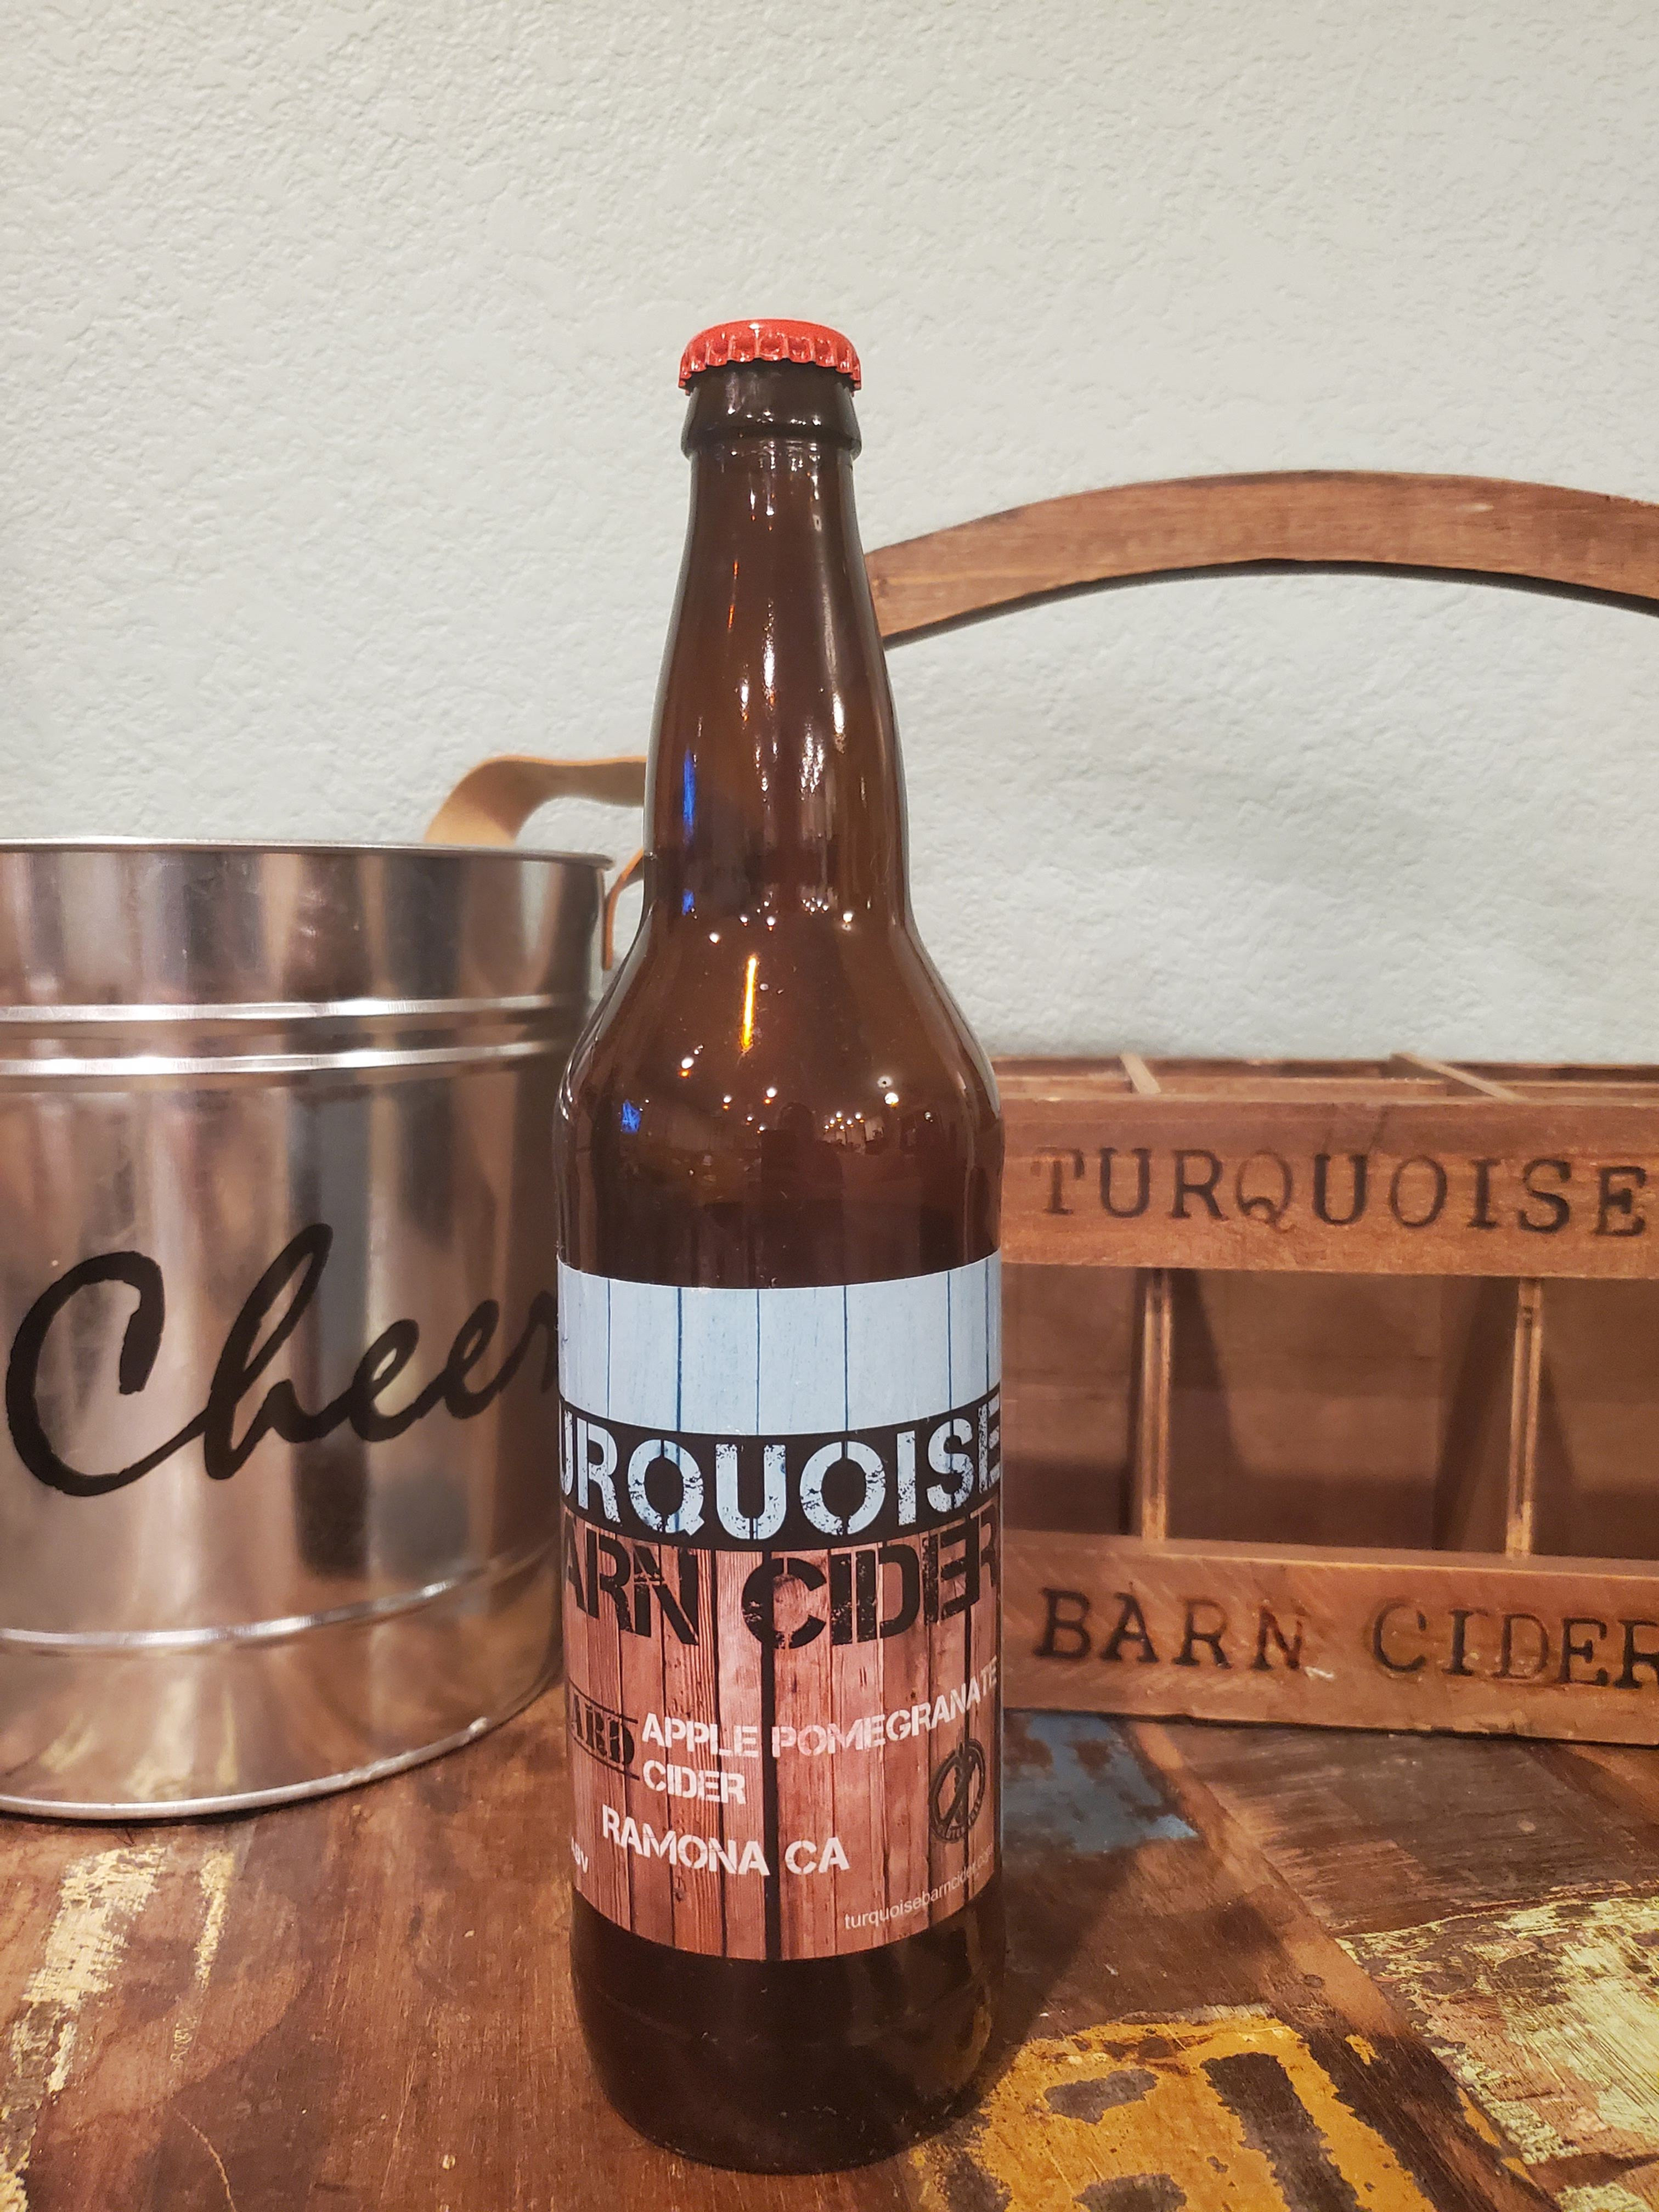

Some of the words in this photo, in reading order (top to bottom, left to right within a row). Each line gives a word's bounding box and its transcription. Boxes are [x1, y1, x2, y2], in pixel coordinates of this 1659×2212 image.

[1030, 1147, 1647, 1238] TURQUOISE
[1034, 1582, 1308, 1671] BARN
[641, 1713, 758, 1756] APPLE
[772, 1655, 997, 1758] POMEGRANATE
[642, 1759, 747, 1805] CIDER
[601, 1803, 770, 1876] RAMONA
[784, 1837, 849, 1875] CA
